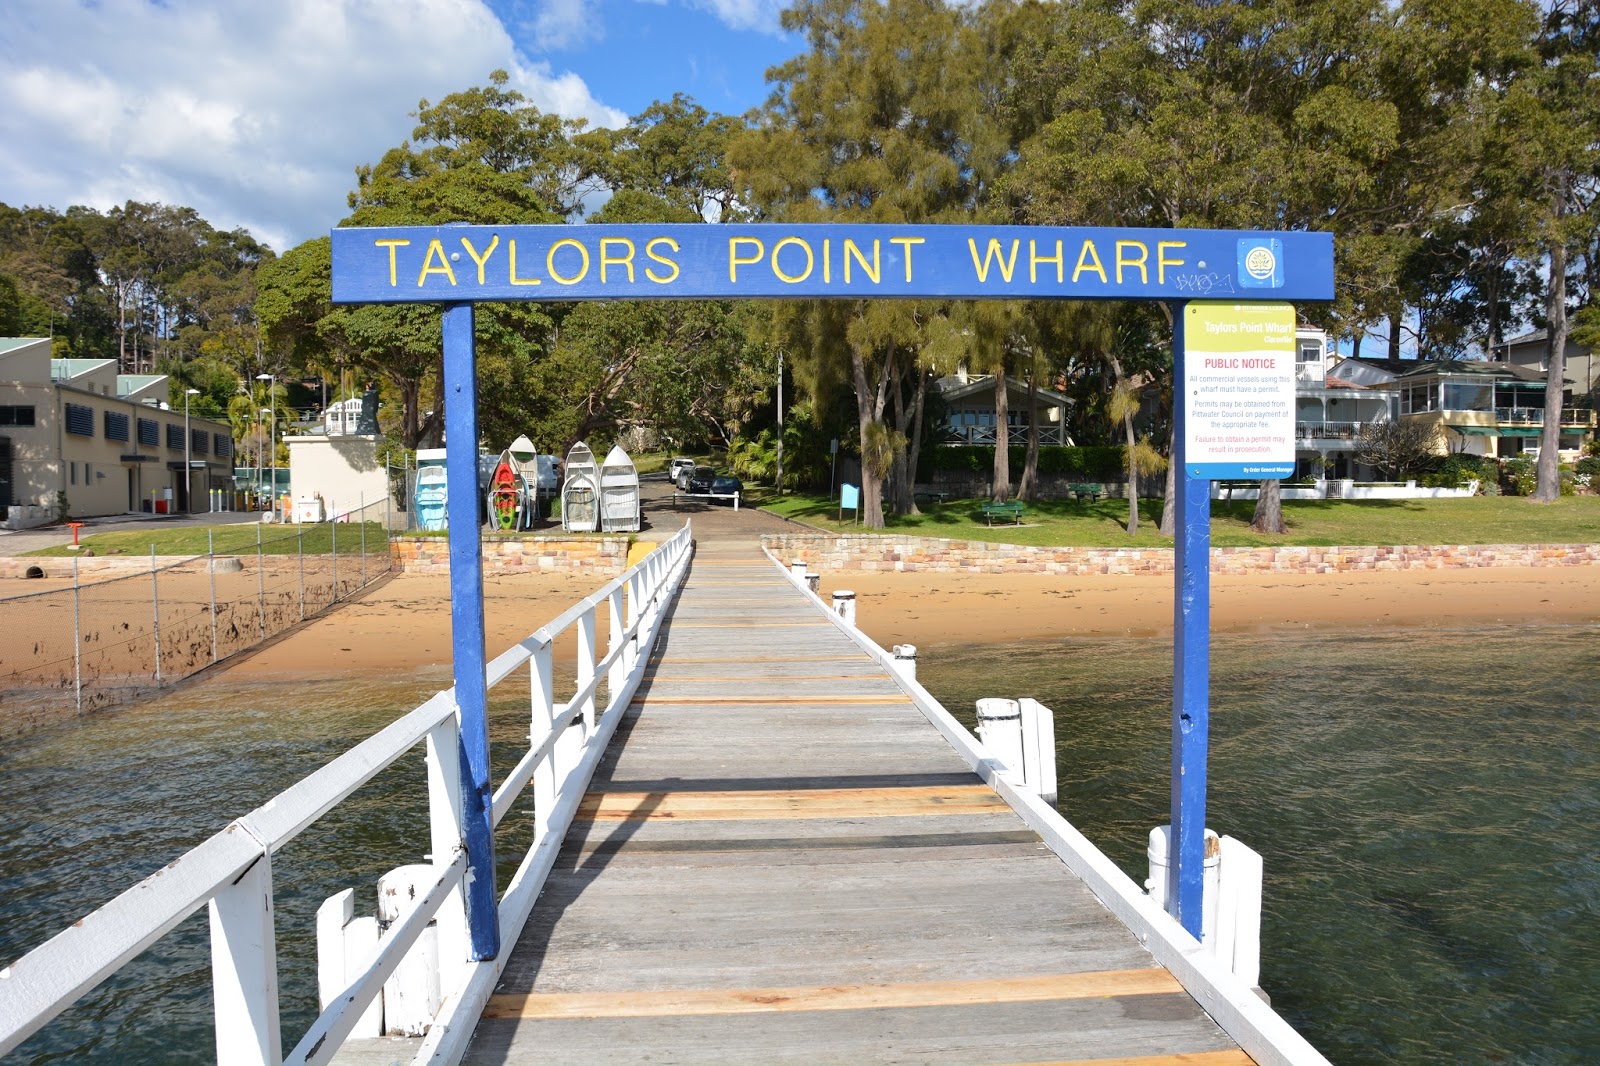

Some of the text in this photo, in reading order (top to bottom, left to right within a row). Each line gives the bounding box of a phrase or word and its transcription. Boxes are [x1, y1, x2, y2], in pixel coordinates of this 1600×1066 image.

[374, 233, 680, 287] TAYLORS
[729, 236, 925, 284] POINT
[967, 237, 1187, 284] WHARF
[1204, 321, 1293, 334] Taylors Point Wharf
[1204, 358, 1276, 368] PUBLIC NOTICE
[1261, 376, 1278, 384] using
[1258, 385, 1280, 394] permit.
[1192, 410, 1219, 418] Pittwater
[1254, 411, 1281, 419] payment
[1222, 421, 1257, 429] appropriate
[1195, 435, 1216, 443] Failure
[1251, 436, 1271, 444] permit
